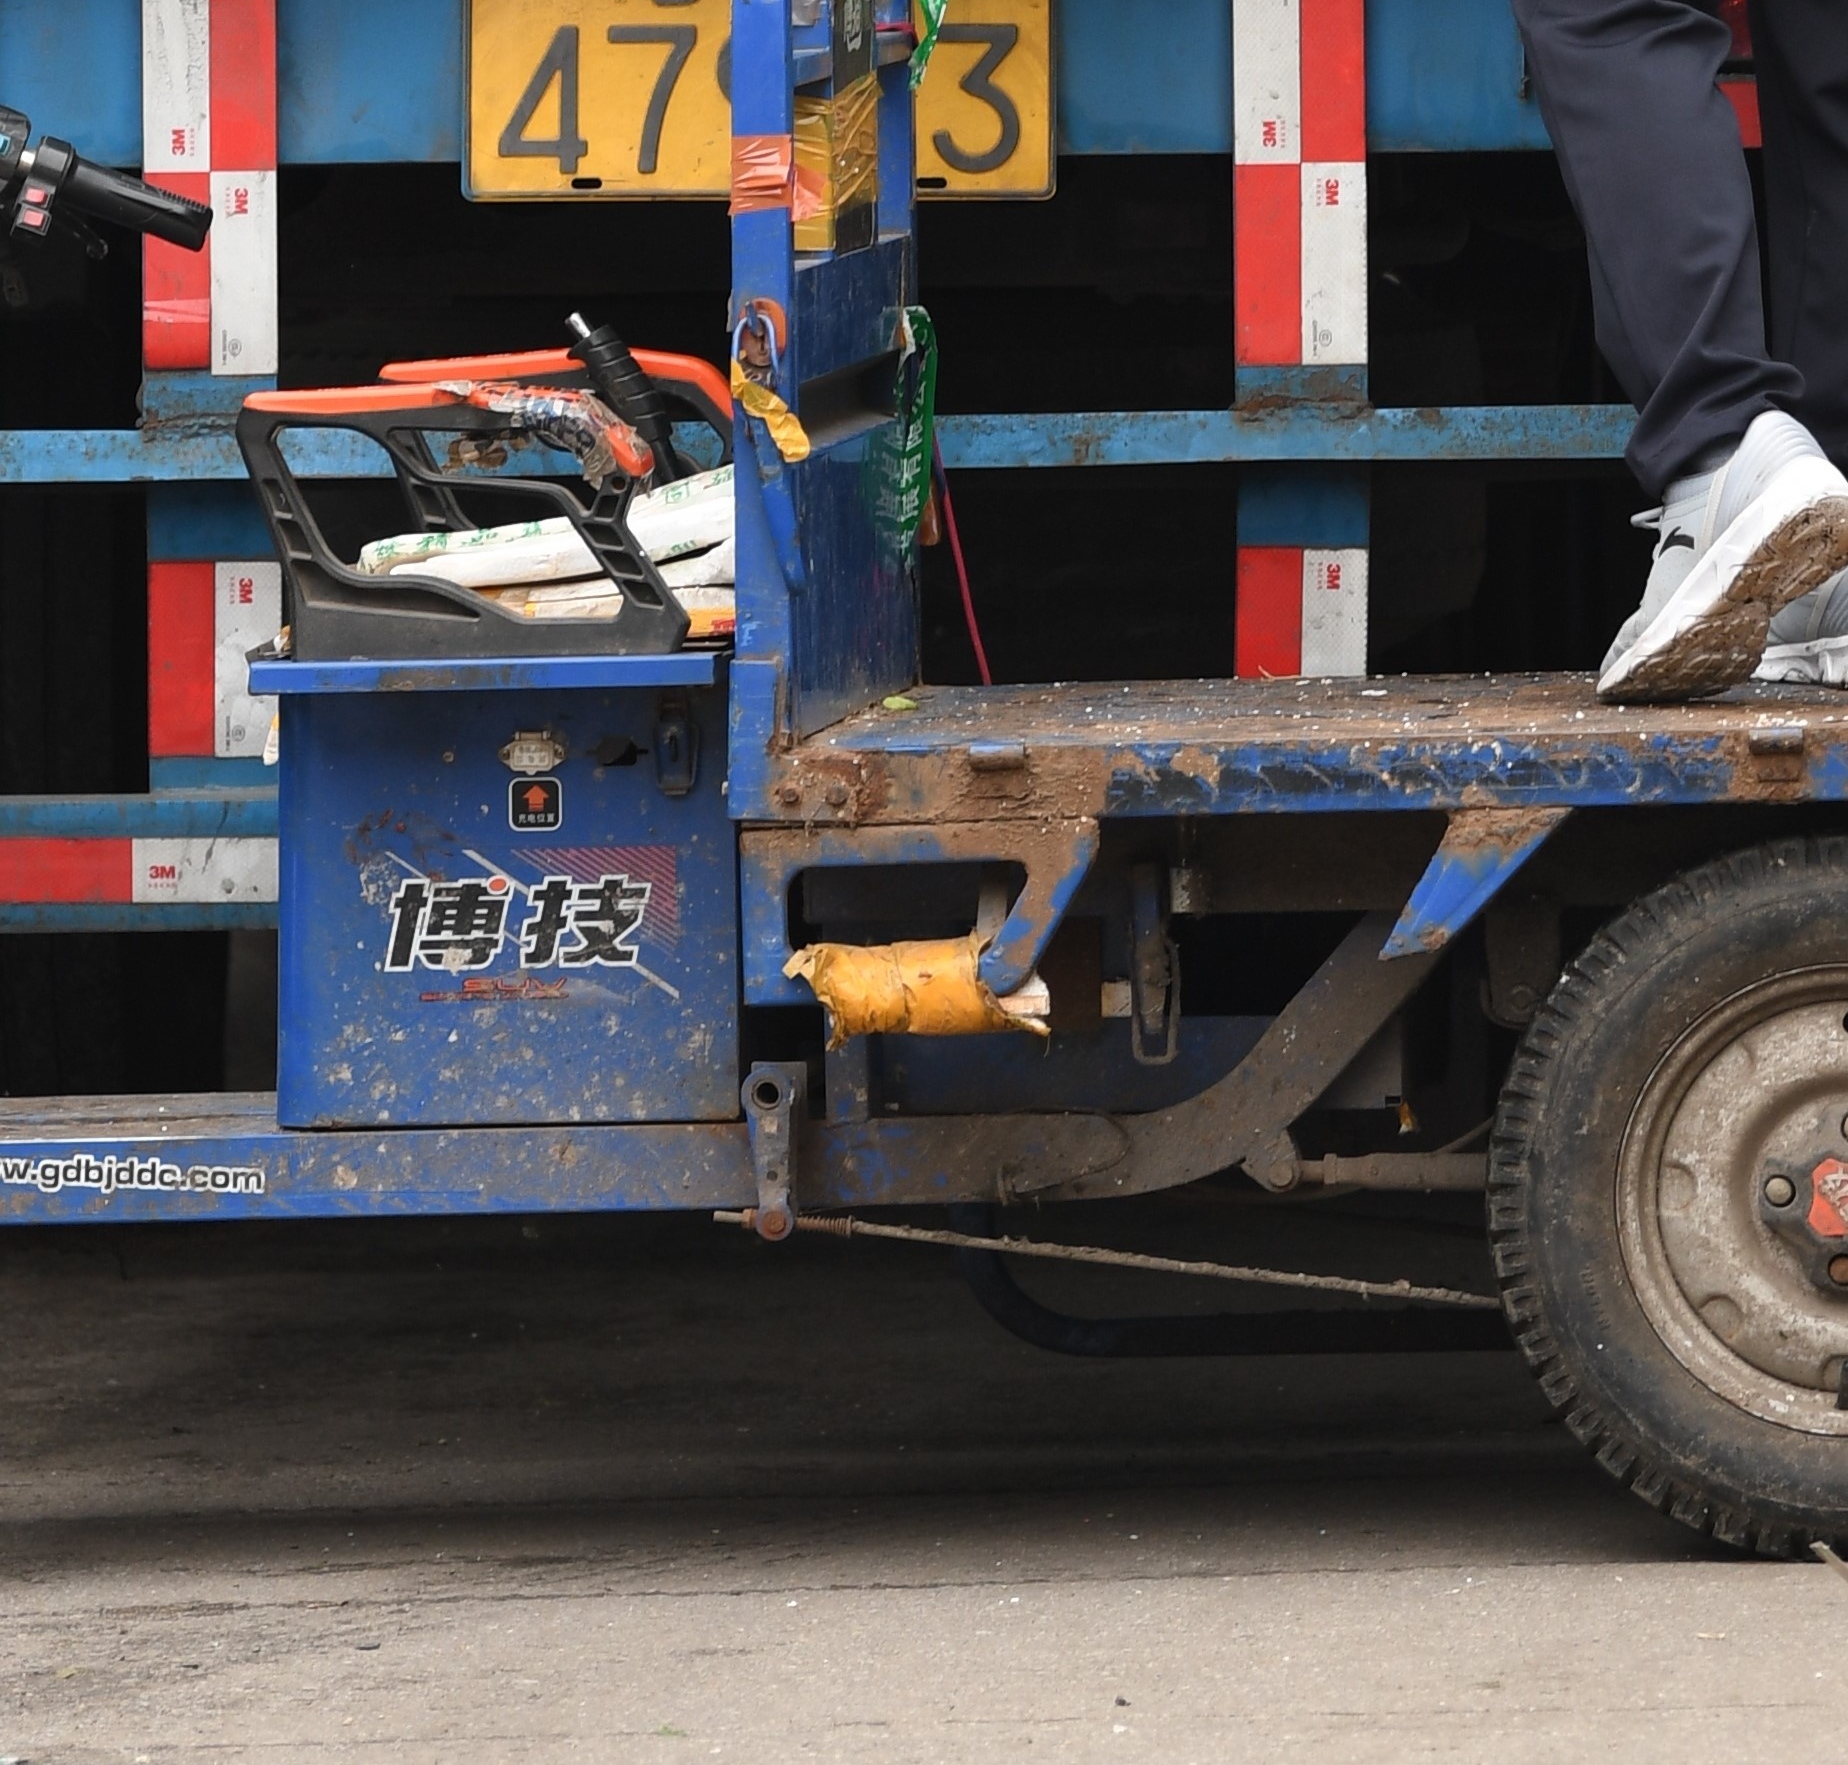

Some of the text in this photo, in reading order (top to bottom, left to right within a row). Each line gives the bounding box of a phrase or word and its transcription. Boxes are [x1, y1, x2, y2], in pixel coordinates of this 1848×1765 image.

[171, 129, 186, 157] 3M
[1262, 120, 1278, 148] 3M
[234, 187, 249, 216] 3M
[1326, 178, 1340, 206] 3M
[239, 576, 253, 605] 3M
[1325, 564, 1341, 590] 3M
[518, 813, 555, 824] 充电位置
[148, 865, 176, 880] 3M
[384, 873, 652, 972] 博技
